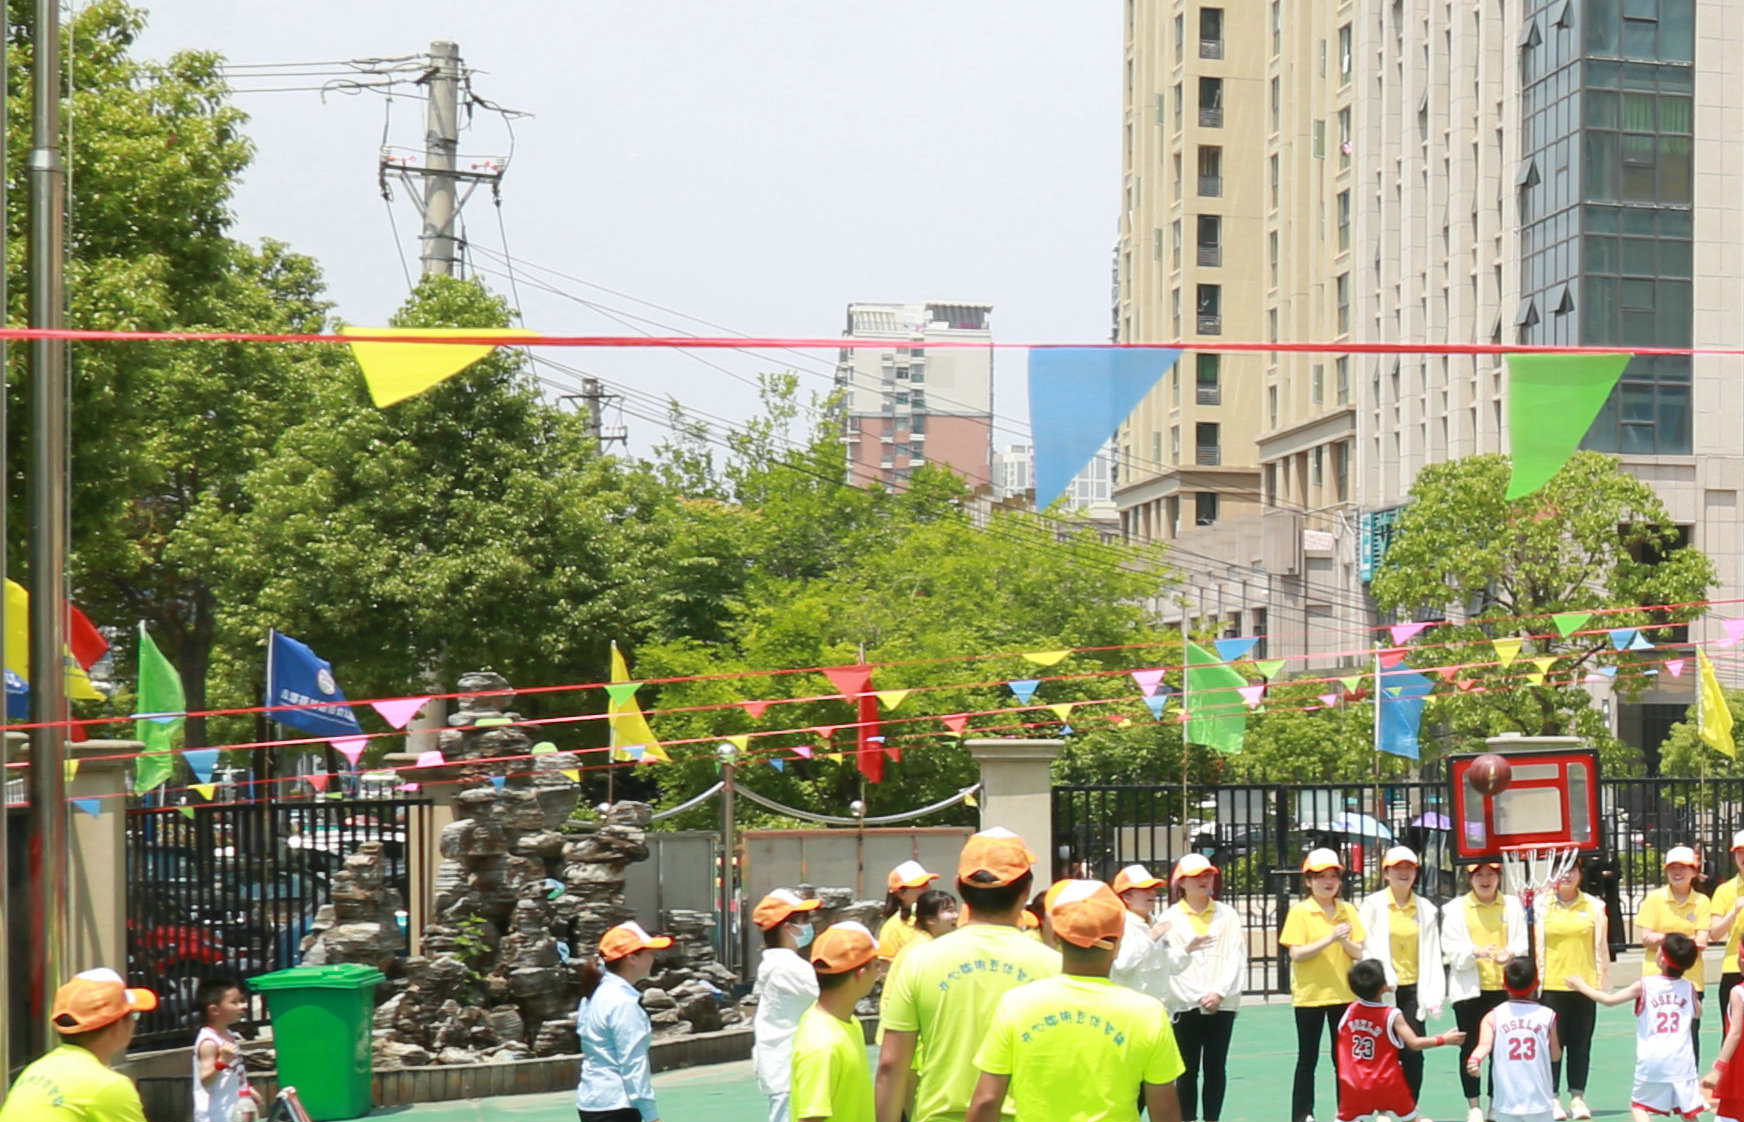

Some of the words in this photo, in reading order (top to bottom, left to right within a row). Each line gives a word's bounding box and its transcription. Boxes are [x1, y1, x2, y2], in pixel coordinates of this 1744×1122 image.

[1656, 1011, 1681, 1034] 23
[1352, 1035, 1376, 1060] 23
[1508, 1037, 1536, 1060] 23
